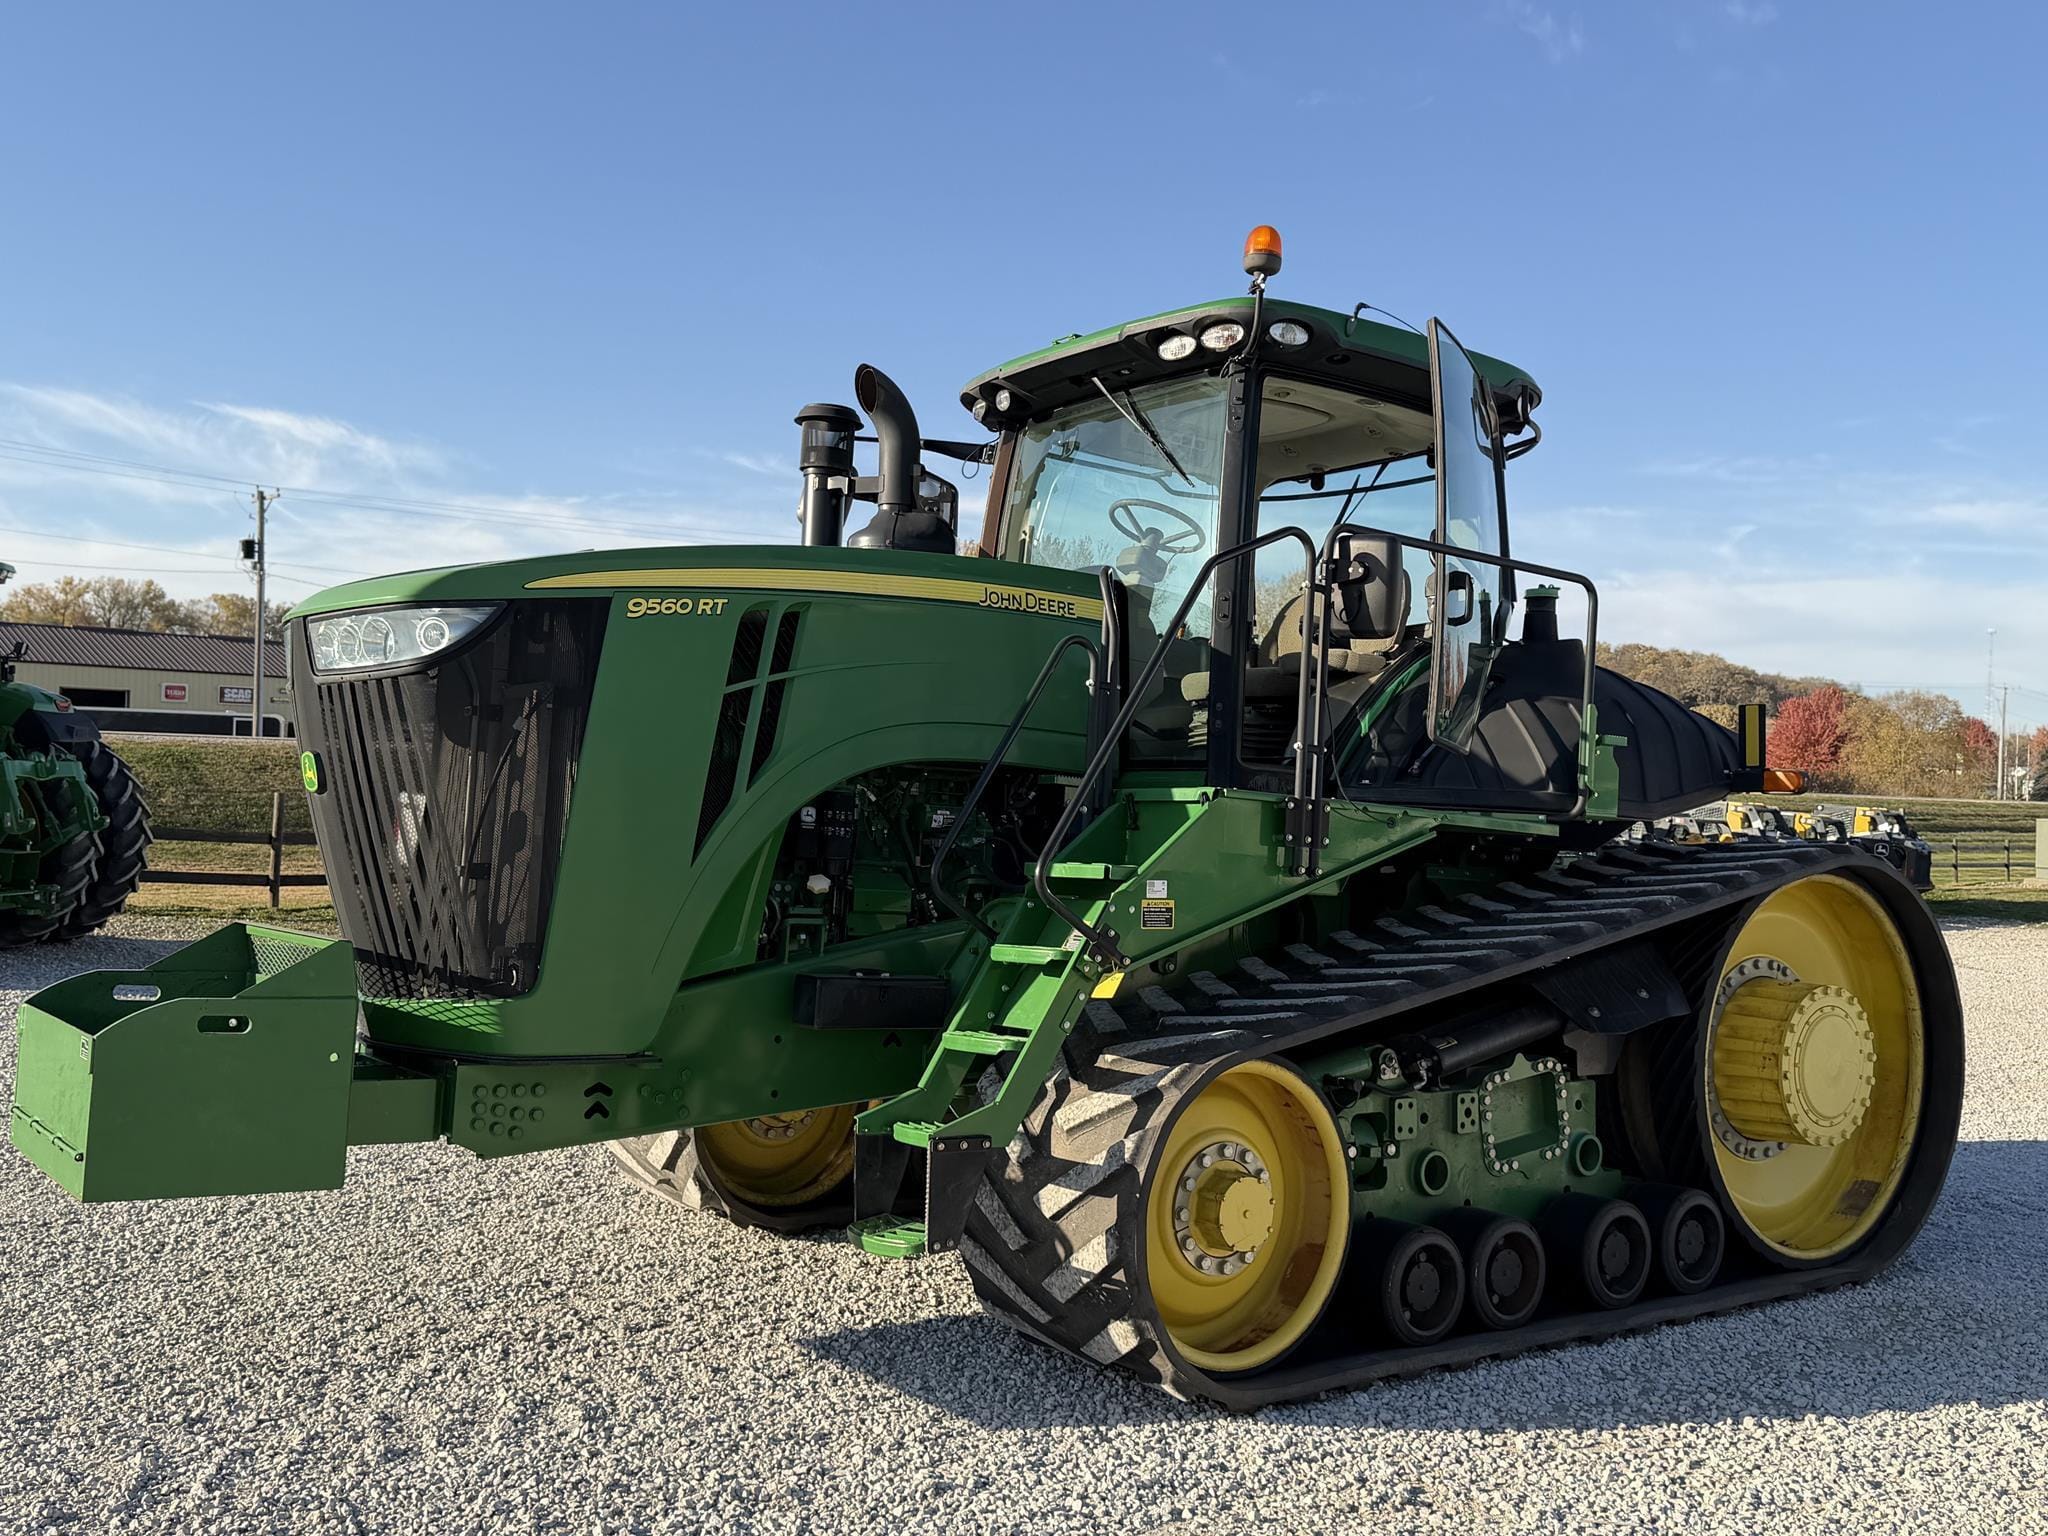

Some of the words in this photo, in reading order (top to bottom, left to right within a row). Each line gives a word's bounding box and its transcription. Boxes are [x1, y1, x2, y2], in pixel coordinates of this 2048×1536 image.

[626, 597, 693, 618] 9560
[696, 598, 729, 615] RT
[979, 587, 1022, 609] JOHN
[1025, 592, 1077, 616] DEERE
[224, 688, 252, 698] SCAG
